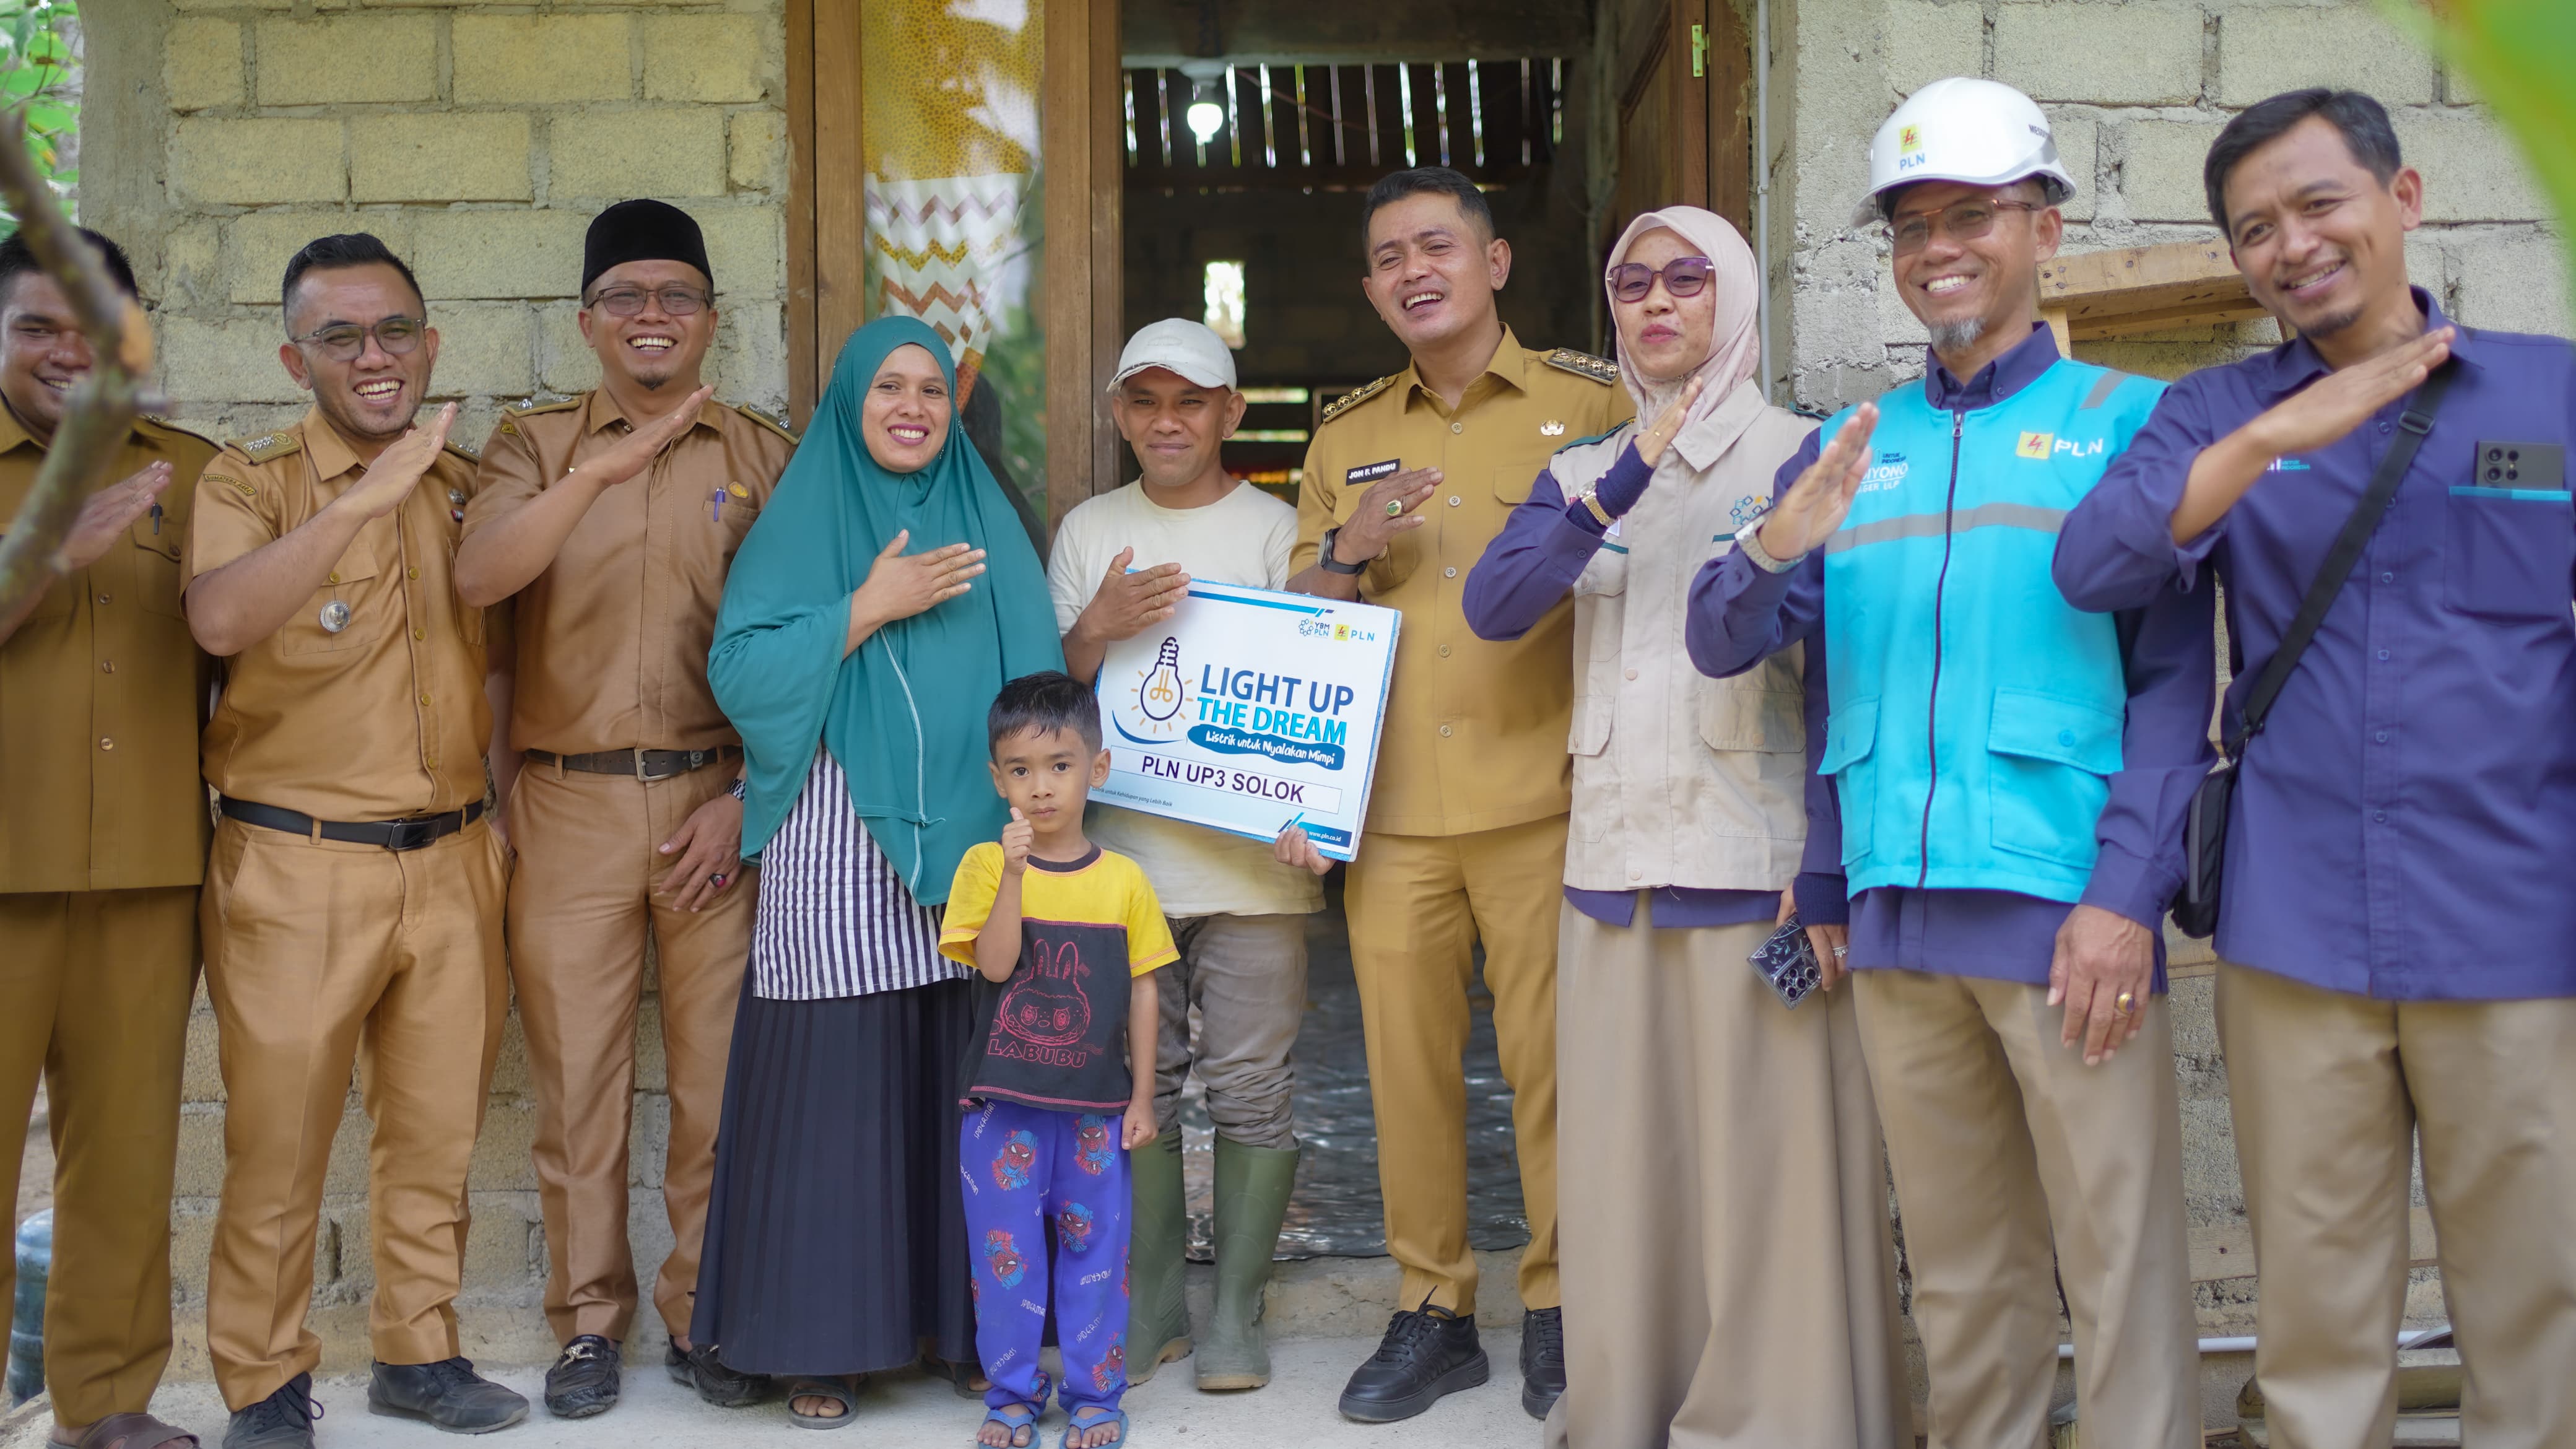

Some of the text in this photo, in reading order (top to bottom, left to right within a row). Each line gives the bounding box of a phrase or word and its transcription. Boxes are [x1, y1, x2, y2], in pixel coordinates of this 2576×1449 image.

[1900, 153, 1925, 170] PLN
[2053, 438, 2104, 456] PLN
[1349, 469, 1364, 479] JON
[1372, 463, 1396, 474] PANDU
[1314, 629, 1329, 637] PLN
[1315, 622, 1330, 630] YBM
[1351, 630, 1375, 642] PLN
[1201, 664, 1354, 715] LIGHT UP
[1197, 697, 1347, 746] THE DREAM
[1205, 730, 1335, 766] Listrik untuk Nyalakan Mimpi
[1142, 755, 1305, 804] PLN UP3 SOLOK
[1116, 791, 1138, 801] Kehidupan
[1308, 831, 1342, 842] www.pln.co.id
[988, 1039, 1086, 1068] LABUBU
[973, 1102, 996, 1139] SPIDERMAN
[960, 1162, 979, 1196] DERMAN
[1020, 1299, 1046, 1317] SPIDERMA
